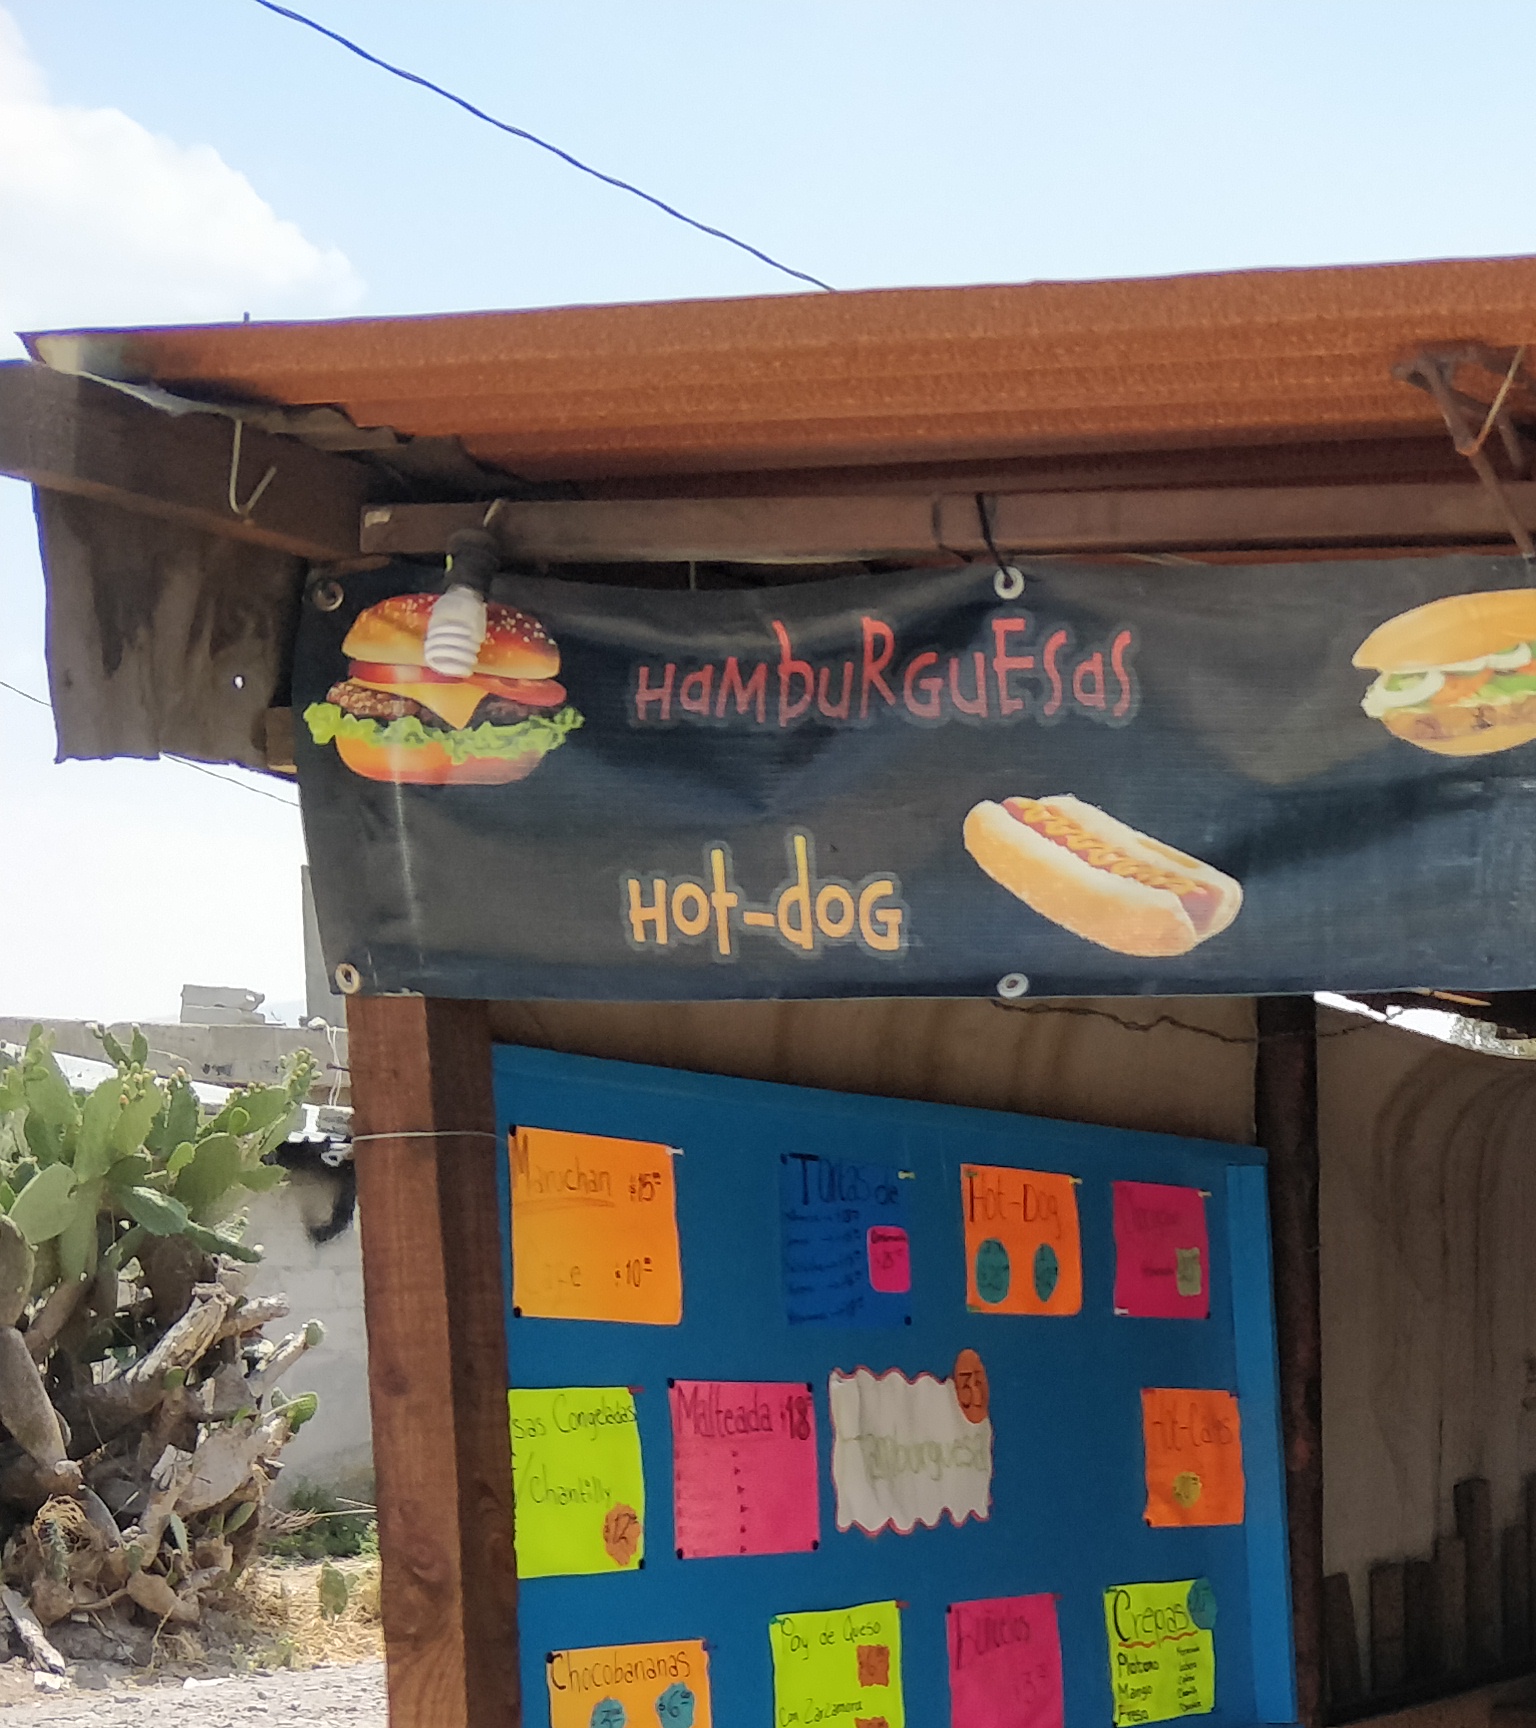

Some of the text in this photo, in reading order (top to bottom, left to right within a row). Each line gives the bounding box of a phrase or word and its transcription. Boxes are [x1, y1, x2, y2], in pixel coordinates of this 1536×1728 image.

[677, 1383, 774, 1439] Malteada
[841, 1614, 882, 1643] Queso
[1113, 1588, 1189, 1650] Crepas
[551, 1650, 692, 1692] Chocobananas
